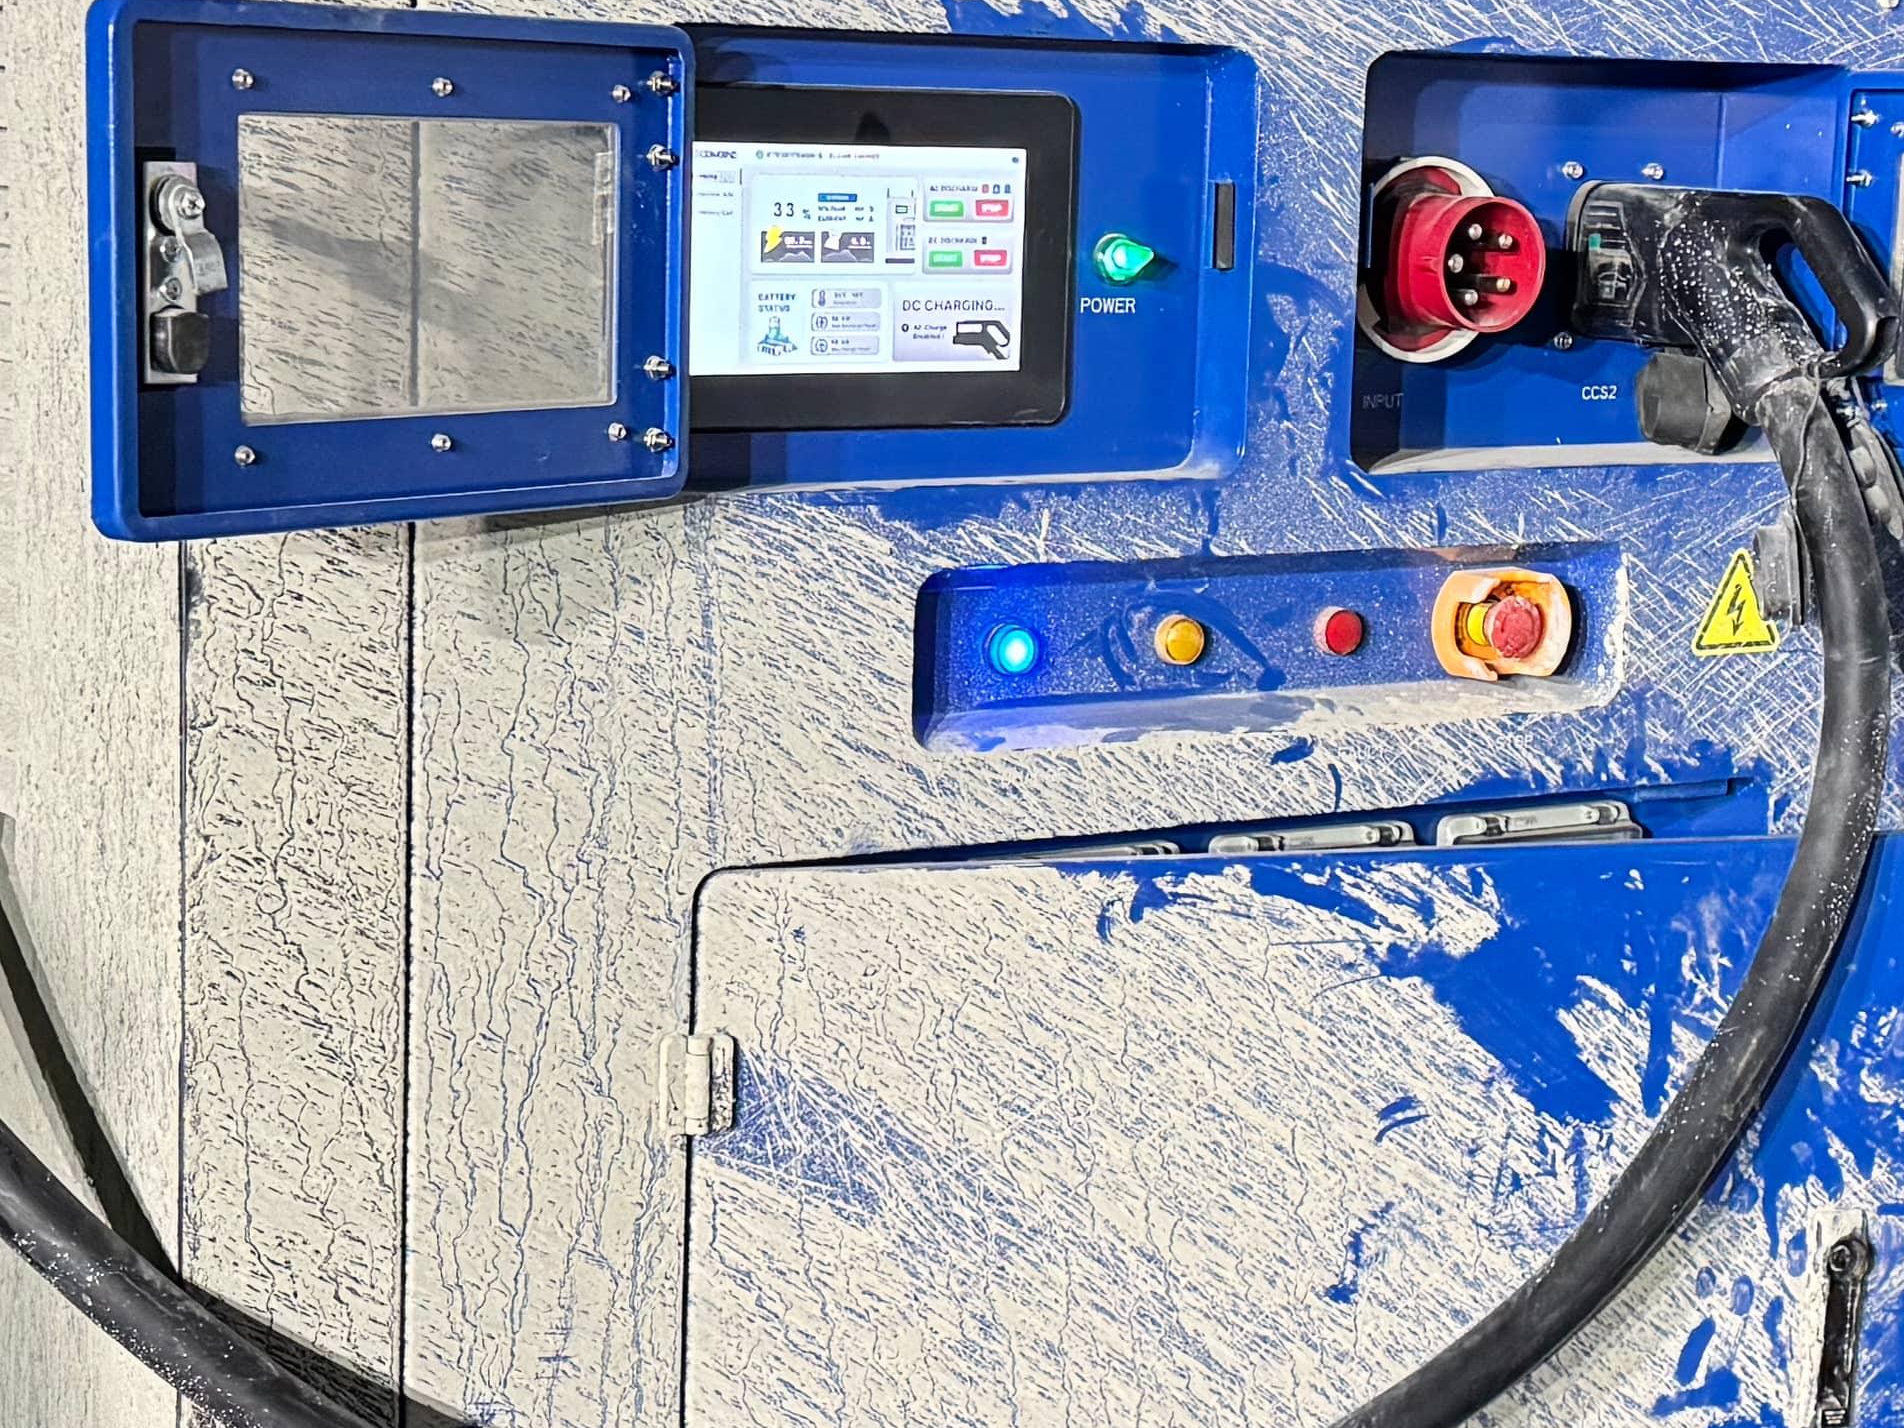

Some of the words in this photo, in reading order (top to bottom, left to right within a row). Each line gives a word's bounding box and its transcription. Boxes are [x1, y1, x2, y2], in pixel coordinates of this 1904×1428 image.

[902, 300, 920, 312] DC
[1080, 297, 1136, 313] POWER
[1582, 385, 1617, 400] CCS2
[1362, 393, 1404, 409] INPUT
